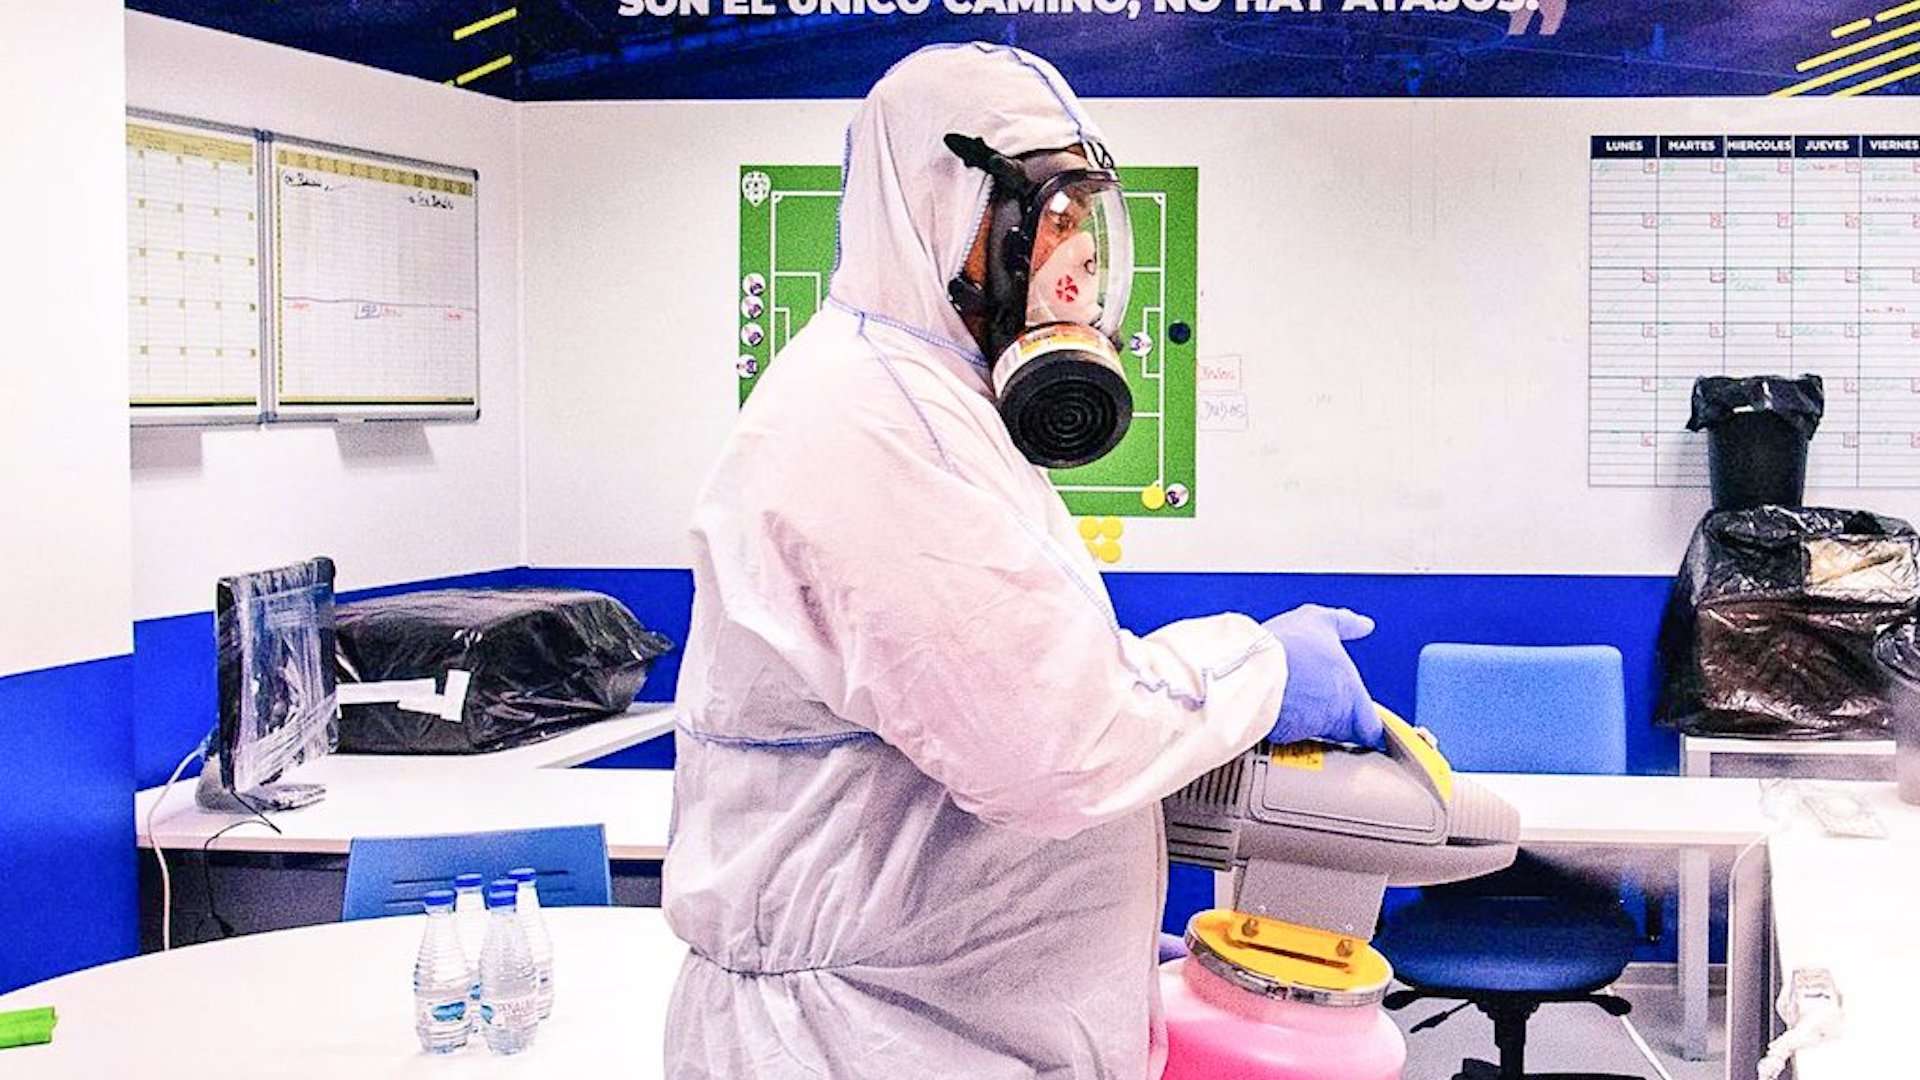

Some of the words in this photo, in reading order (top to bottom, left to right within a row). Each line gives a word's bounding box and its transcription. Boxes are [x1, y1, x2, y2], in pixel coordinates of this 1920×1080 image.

[1605, 140, 1644, 152] LUNES
[1667, 140, 1716, 152] MARTES
[1727, 139, 1792, 152] MIERCOLES
[1804, 140, 1850, 152] JUEVES
[1869, 140, 1920, 151] VIERNES
